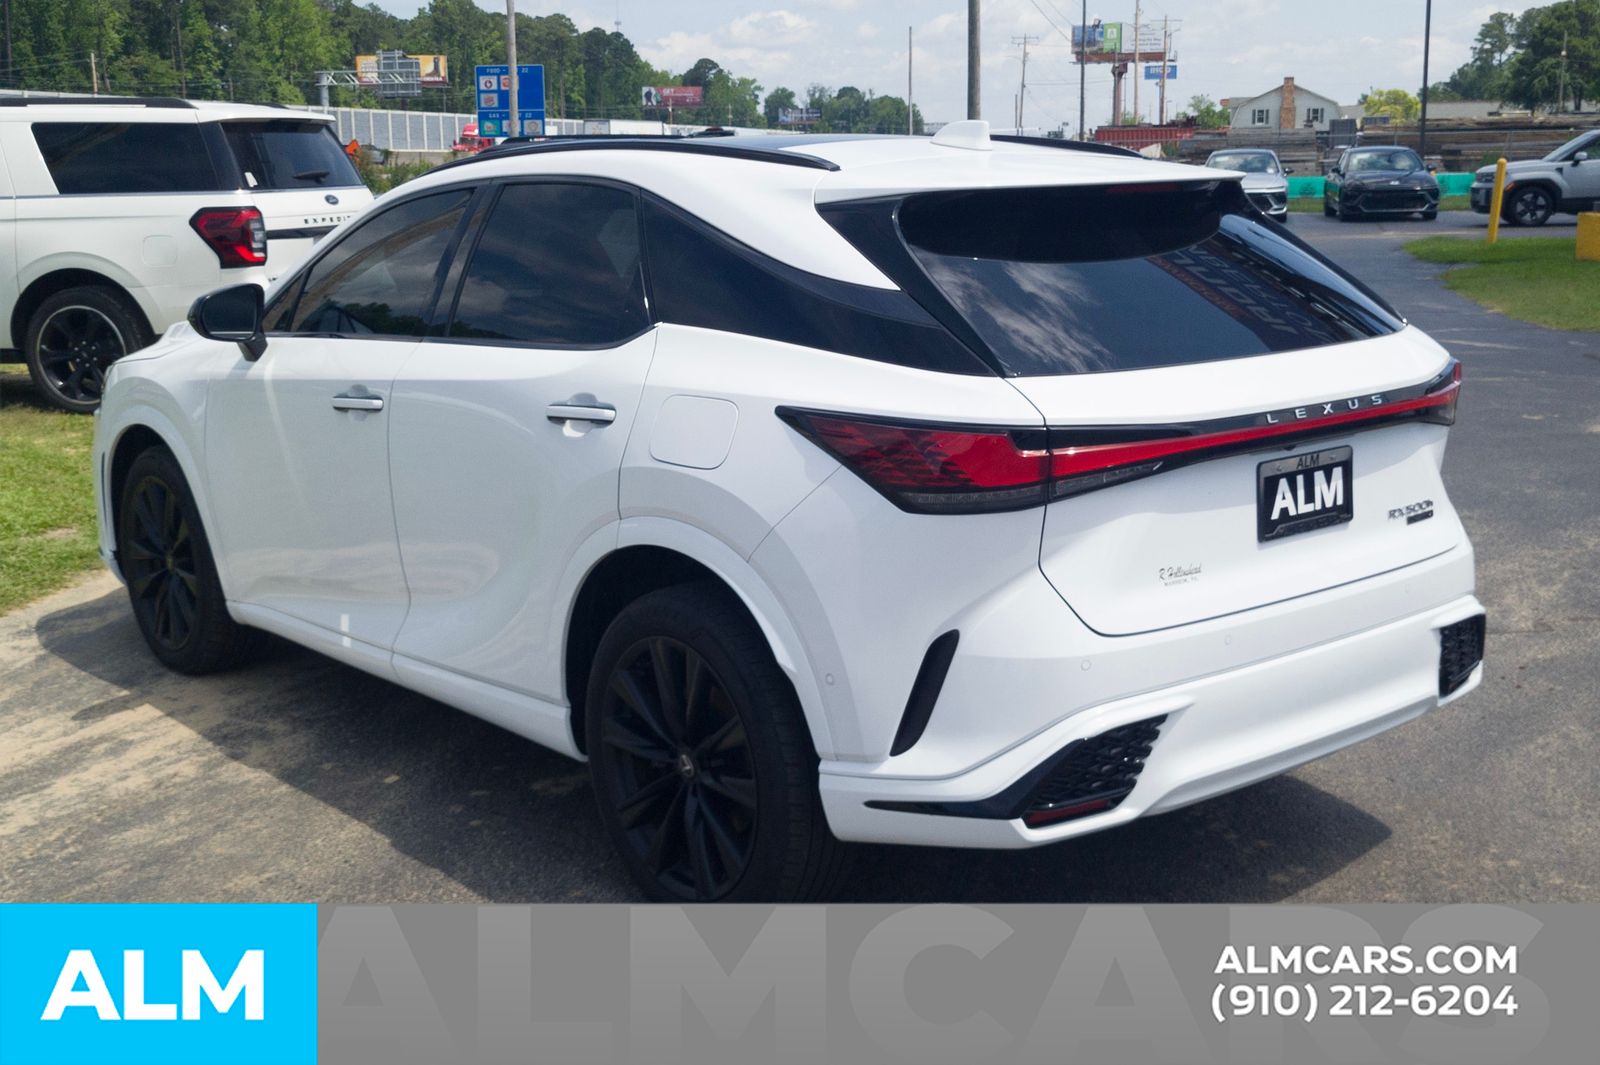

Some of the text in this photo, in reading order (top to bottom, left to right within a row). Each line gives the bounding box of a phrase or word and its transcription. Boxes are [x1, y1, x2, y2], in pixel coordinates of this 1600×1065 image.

[1266, 393, 1383, 425] LEXUS
[1295, 452, 1321, 470] ALM
[1270, 466, 1344, 521] ALM
